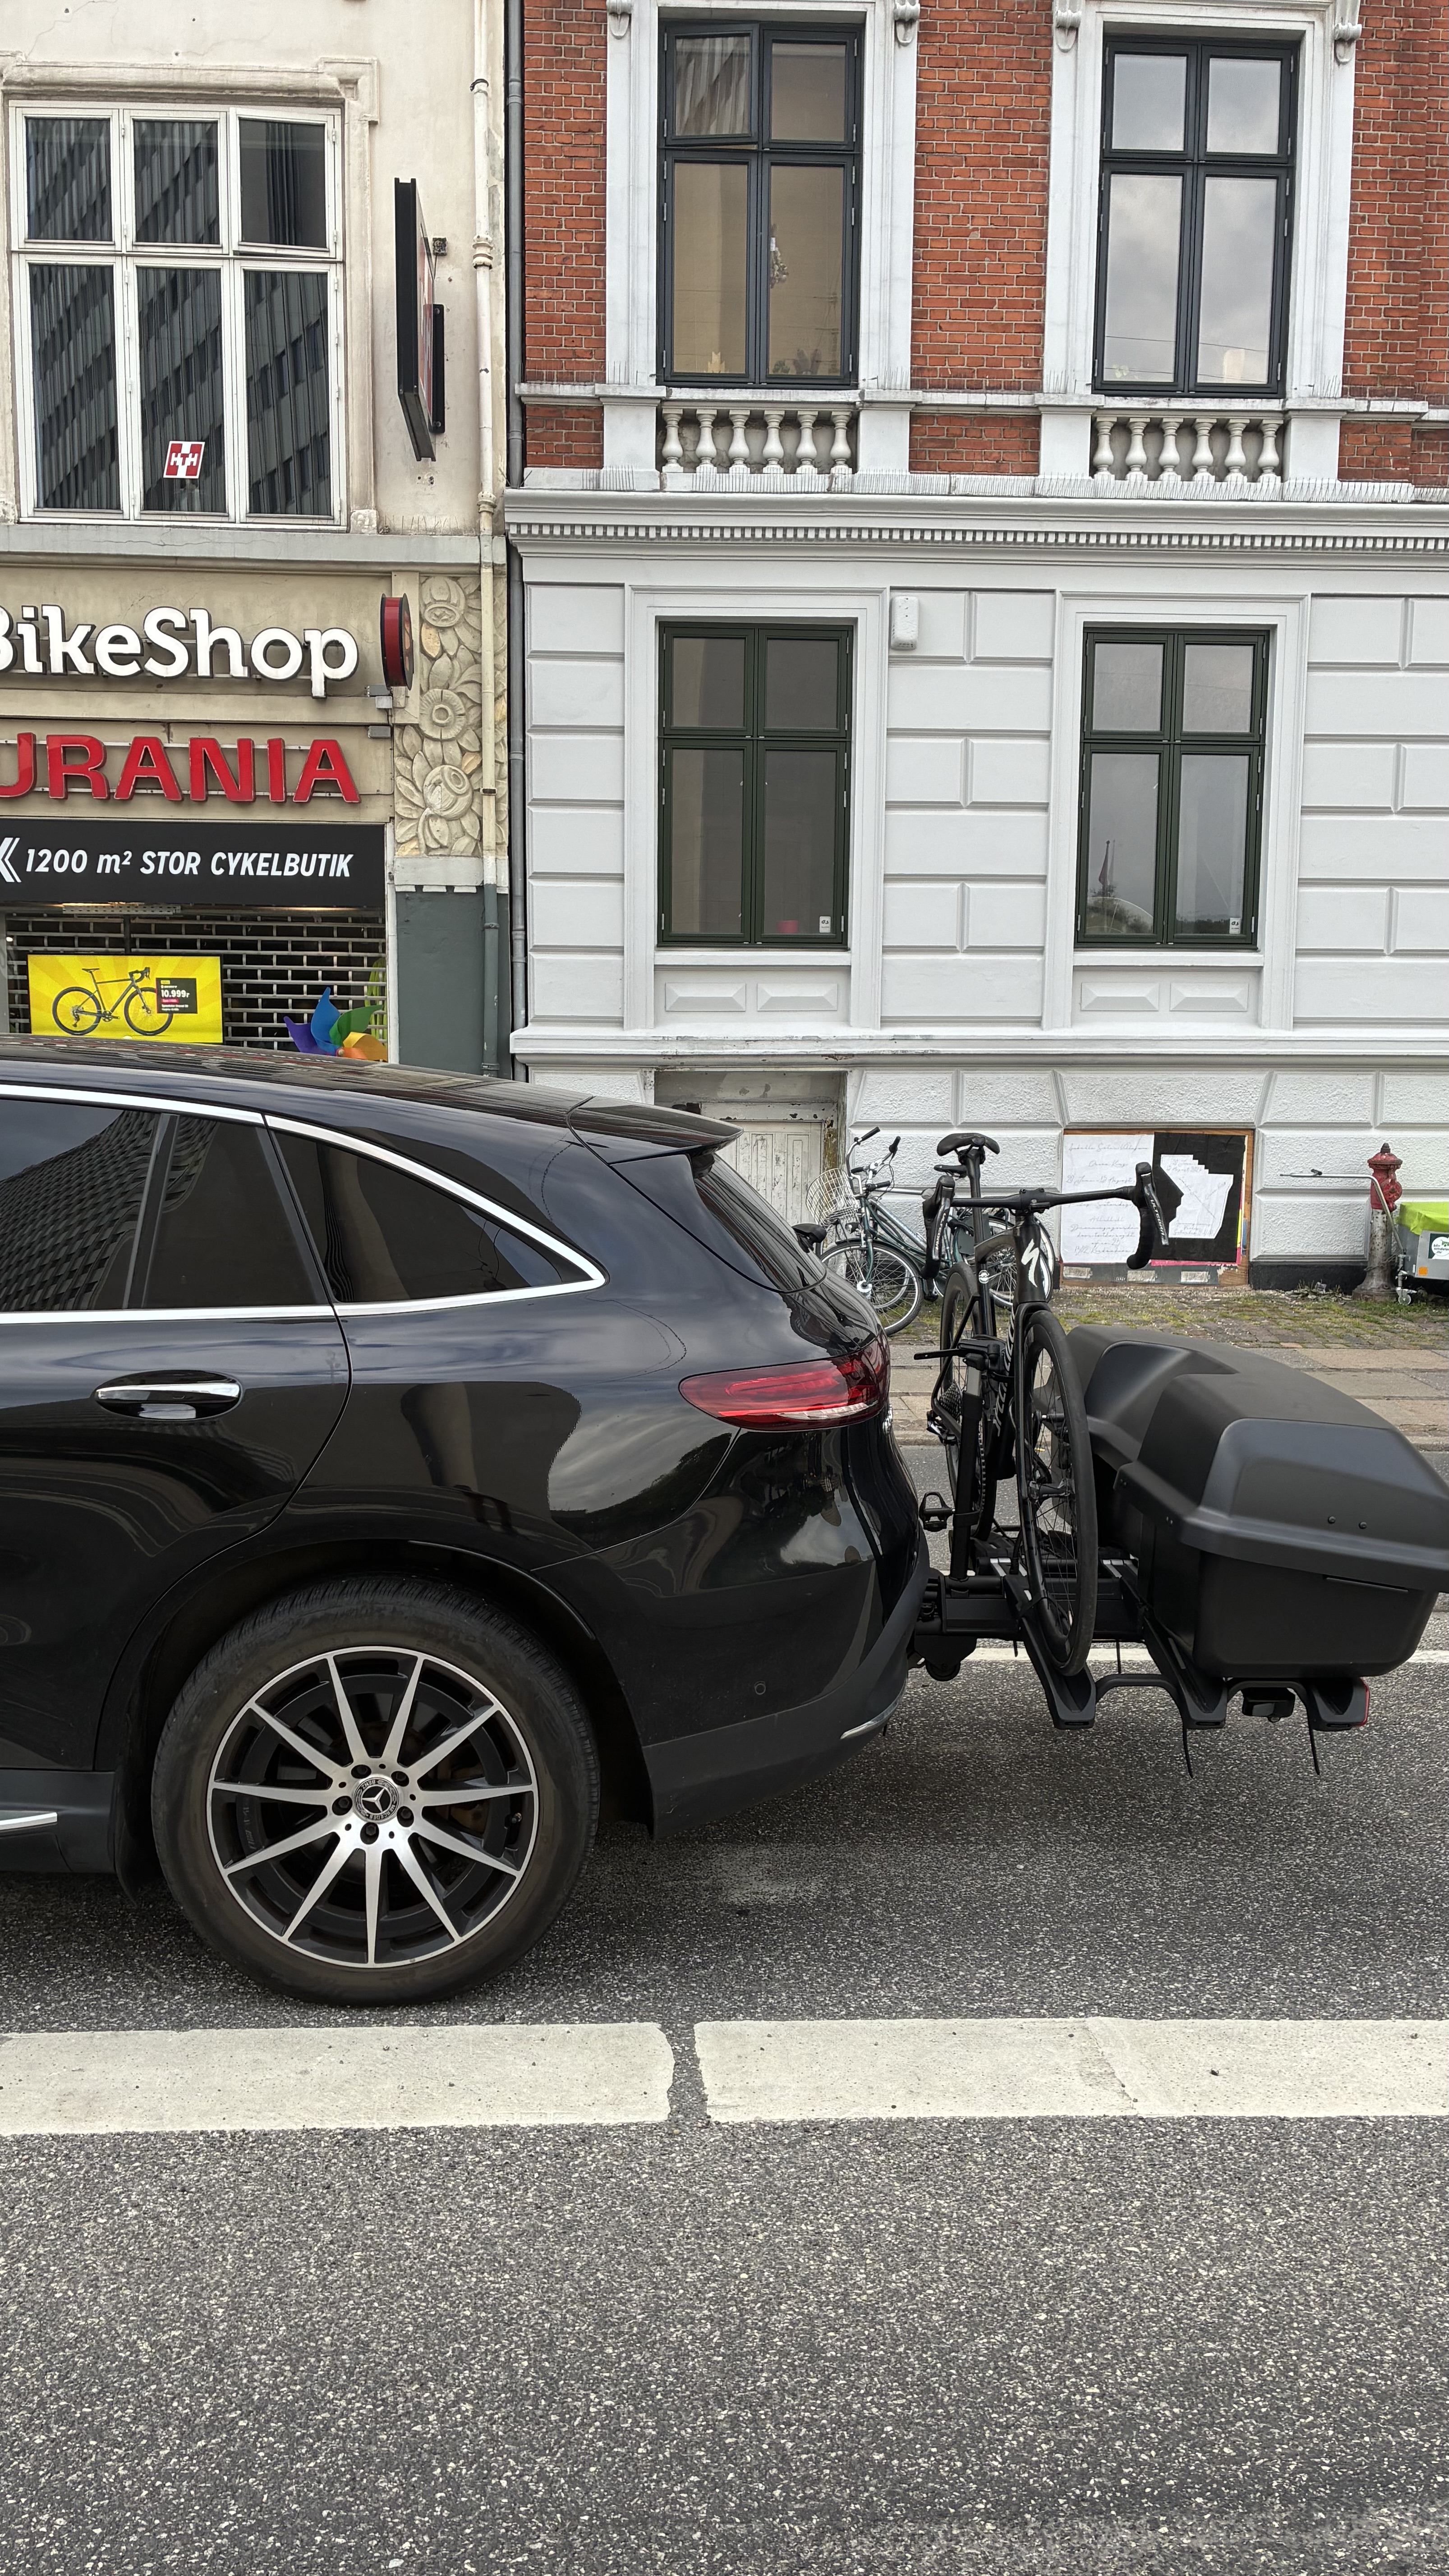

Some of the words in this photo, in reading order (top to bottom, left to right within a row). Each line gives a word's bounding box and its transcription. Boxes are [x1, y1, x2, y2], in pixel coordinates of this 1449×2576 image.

[170, 452, 198, 466] HTH
[26, 848, 87, 873] 1200
[140, 851, 201, 875] STOR
[211, 852, 354, 877] CYKELBUTIK
